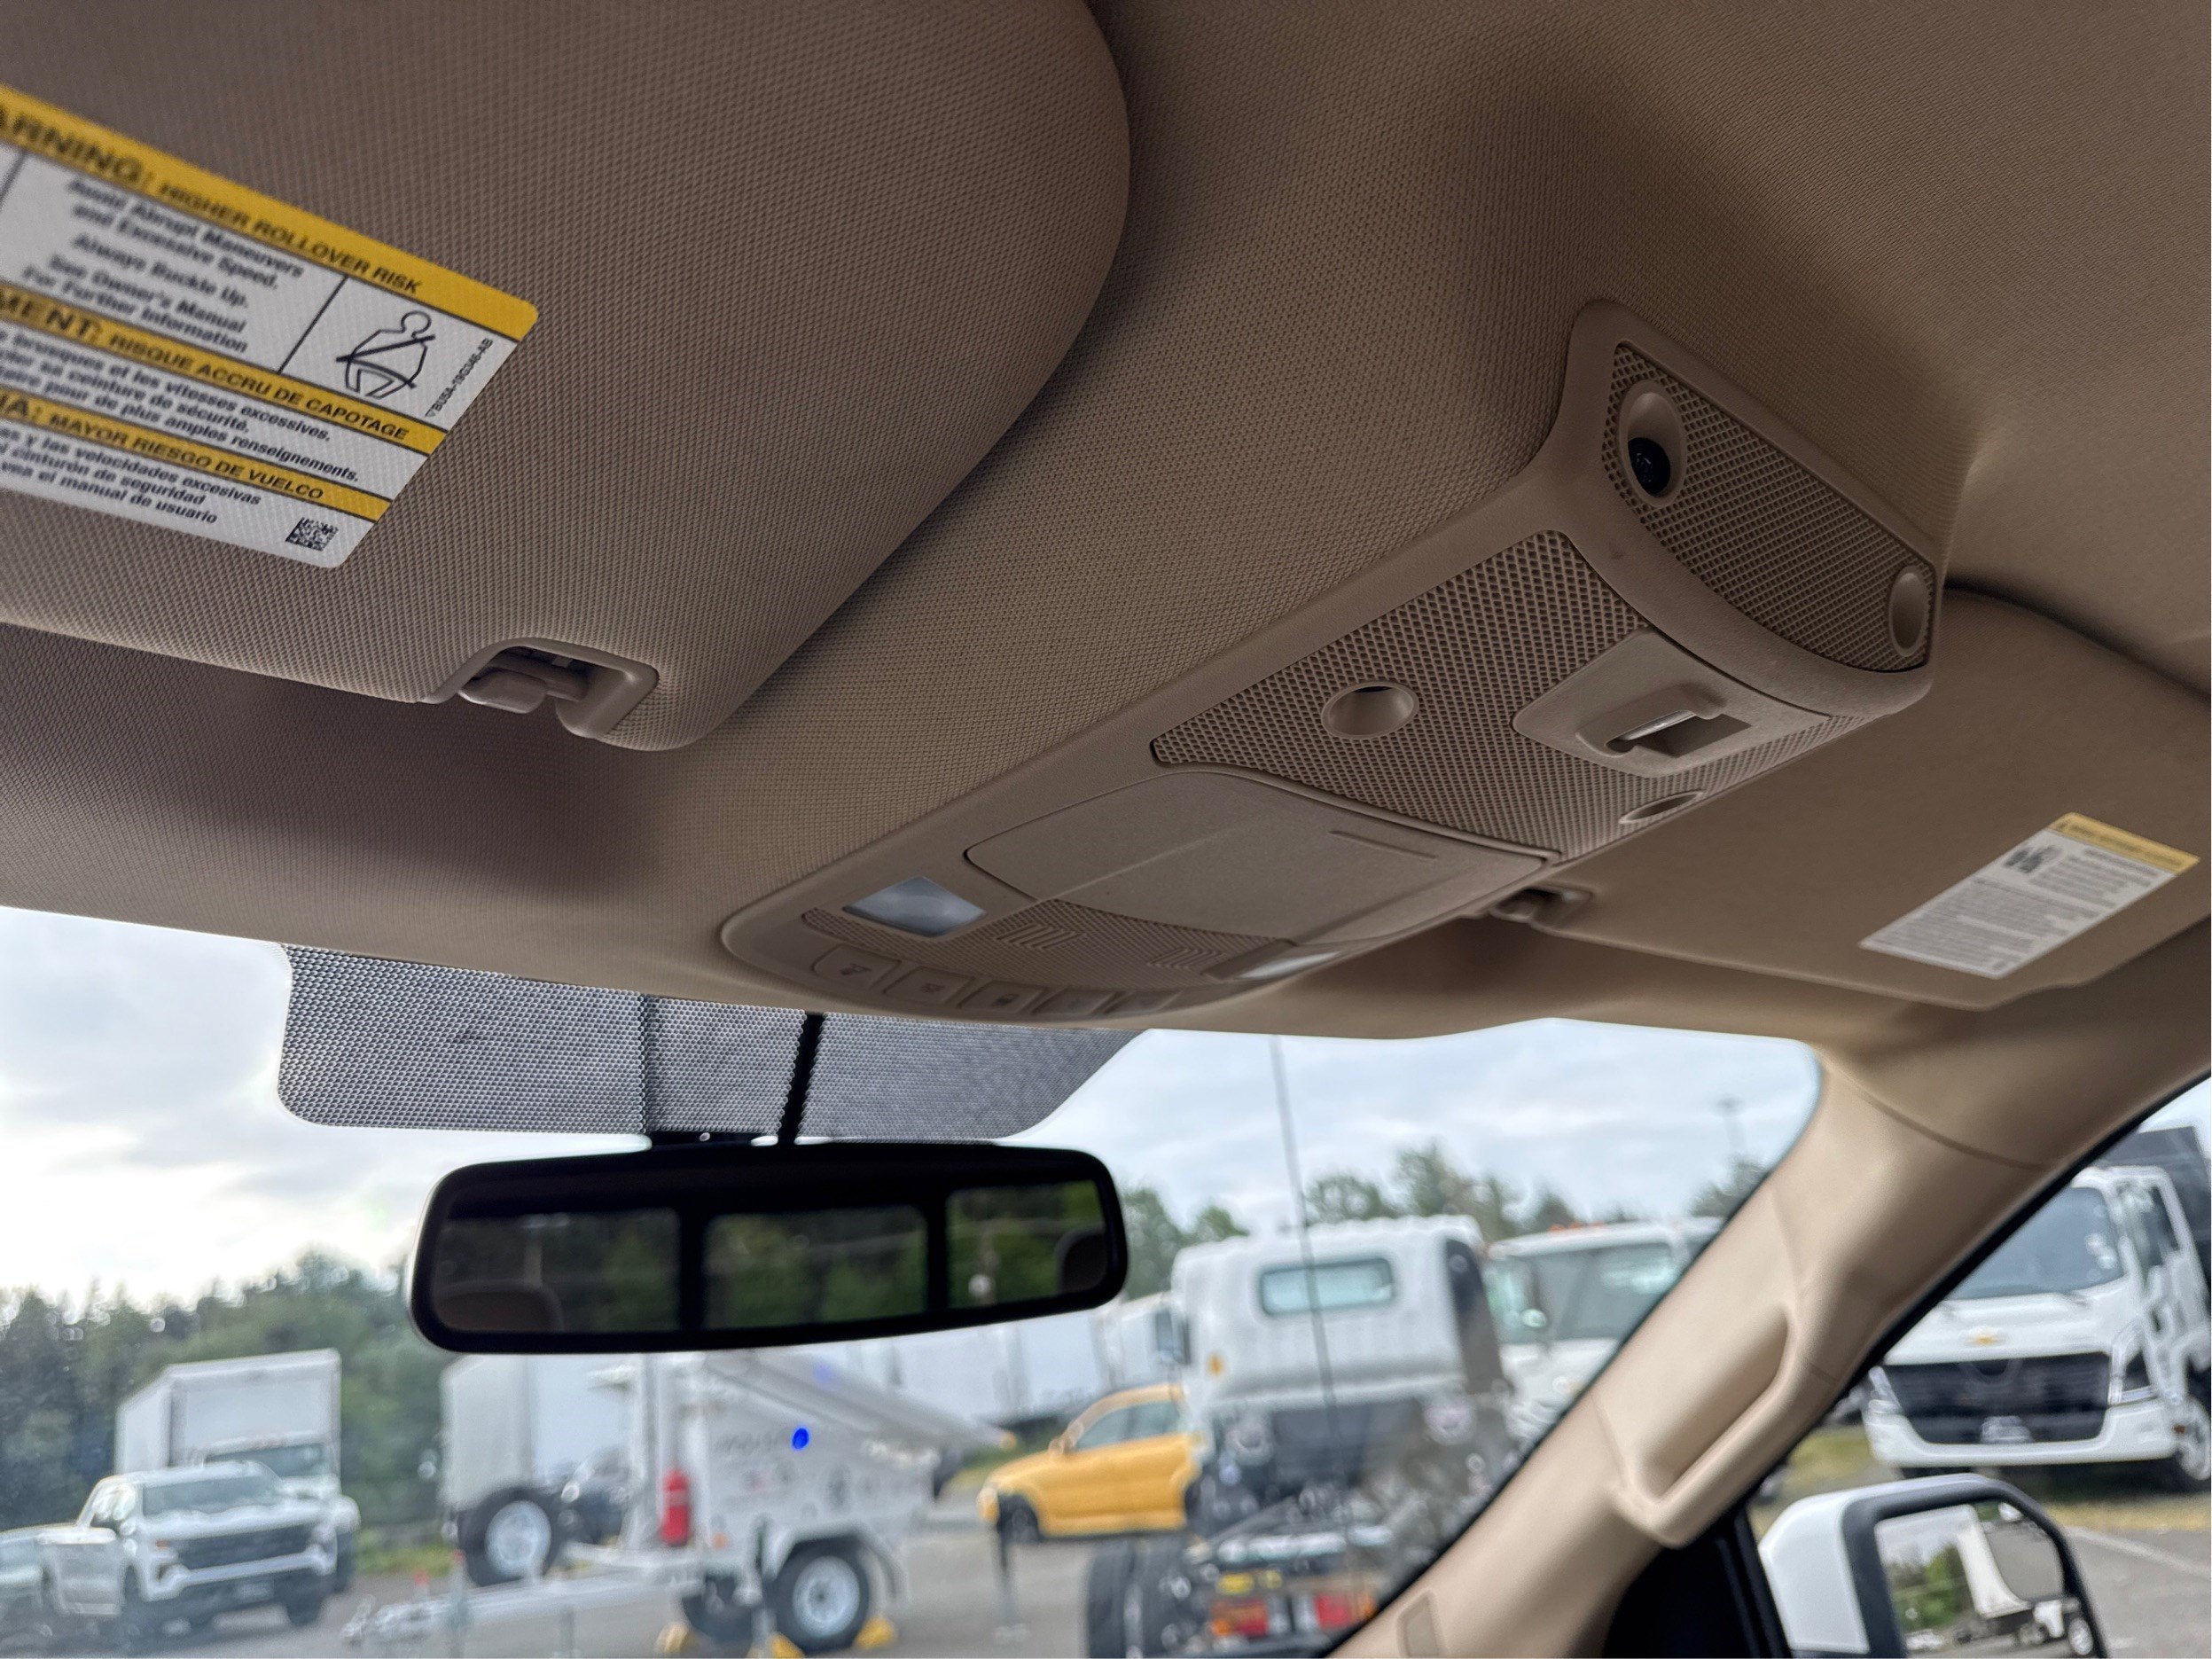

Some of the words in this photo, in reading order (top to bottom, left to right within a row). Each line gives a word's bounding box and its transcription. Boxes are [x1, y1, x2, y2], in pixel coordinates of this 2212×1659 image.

[72, 203, 114, 225] and
[117, 218, 214, 263] Excessive
[219, 255, 277, 289] Speed.
[72, 233, 146, 270] Always
[151, 260, 217, 294] Buckle
[221, 286, 248, 308] Up.
[132, 202, 199, 237] Abrupt
[203, 229, 304, 278] Maneuvers
[158, 182, 250, 229] HIGHER
[253, 219, 371, 273] ROLLOVER
[372, 266, 422, 294] RISK
[50, 254, 86, 278] See
[176, 298, 247, 333] Manual
[61, 280, 135, 314] Further
[141, 308, 248, 352] Information
[12, 332, 105, 372] brusques
[109, 364, 129, 379] et
[133, 371, 160, 388] les
[166, 381, 238, 411] vitesses
[240, 405, 331, 442] excessives.
[40, 360, 64, 377] sa
[67, 371, 146, 401] ceinture
[150, 395, 174, 410] de
[110, 333, 192, 370] RISQUE
[196, 364, 272, 395] ACCRU
[274, 387, 304, 405] DE
[307, 398, 410, 440] CAPOTAGE
[45, 380, 89, 401] pour
[94, 395, 119, 411] de
[120, 403, 161, 423] plus
[164, 417, 228, 442] amples
[231, 435, 358, 481] renseignements.
[49, 413, 129, 444] MAYOR
[133, 436, 212, 468] RIESGO
[215, 461, 245, 476] DE
[248, 469, 324, 499] VUELCO
[12, 448, 90, 476] cinturón
[94, 469, 117, 482] de
[121, 476, 206, 505] seguridad
[38, 471, 58, 483] el
[59, 477, 128, 502] manual
[130, 495, 152, 507] de
[155, 501, 218, 525] usuario
[42, 437, 69, 454] las
[75, 447, 179, 482] velocidades
[183, 478, 262, 505] excesivas
